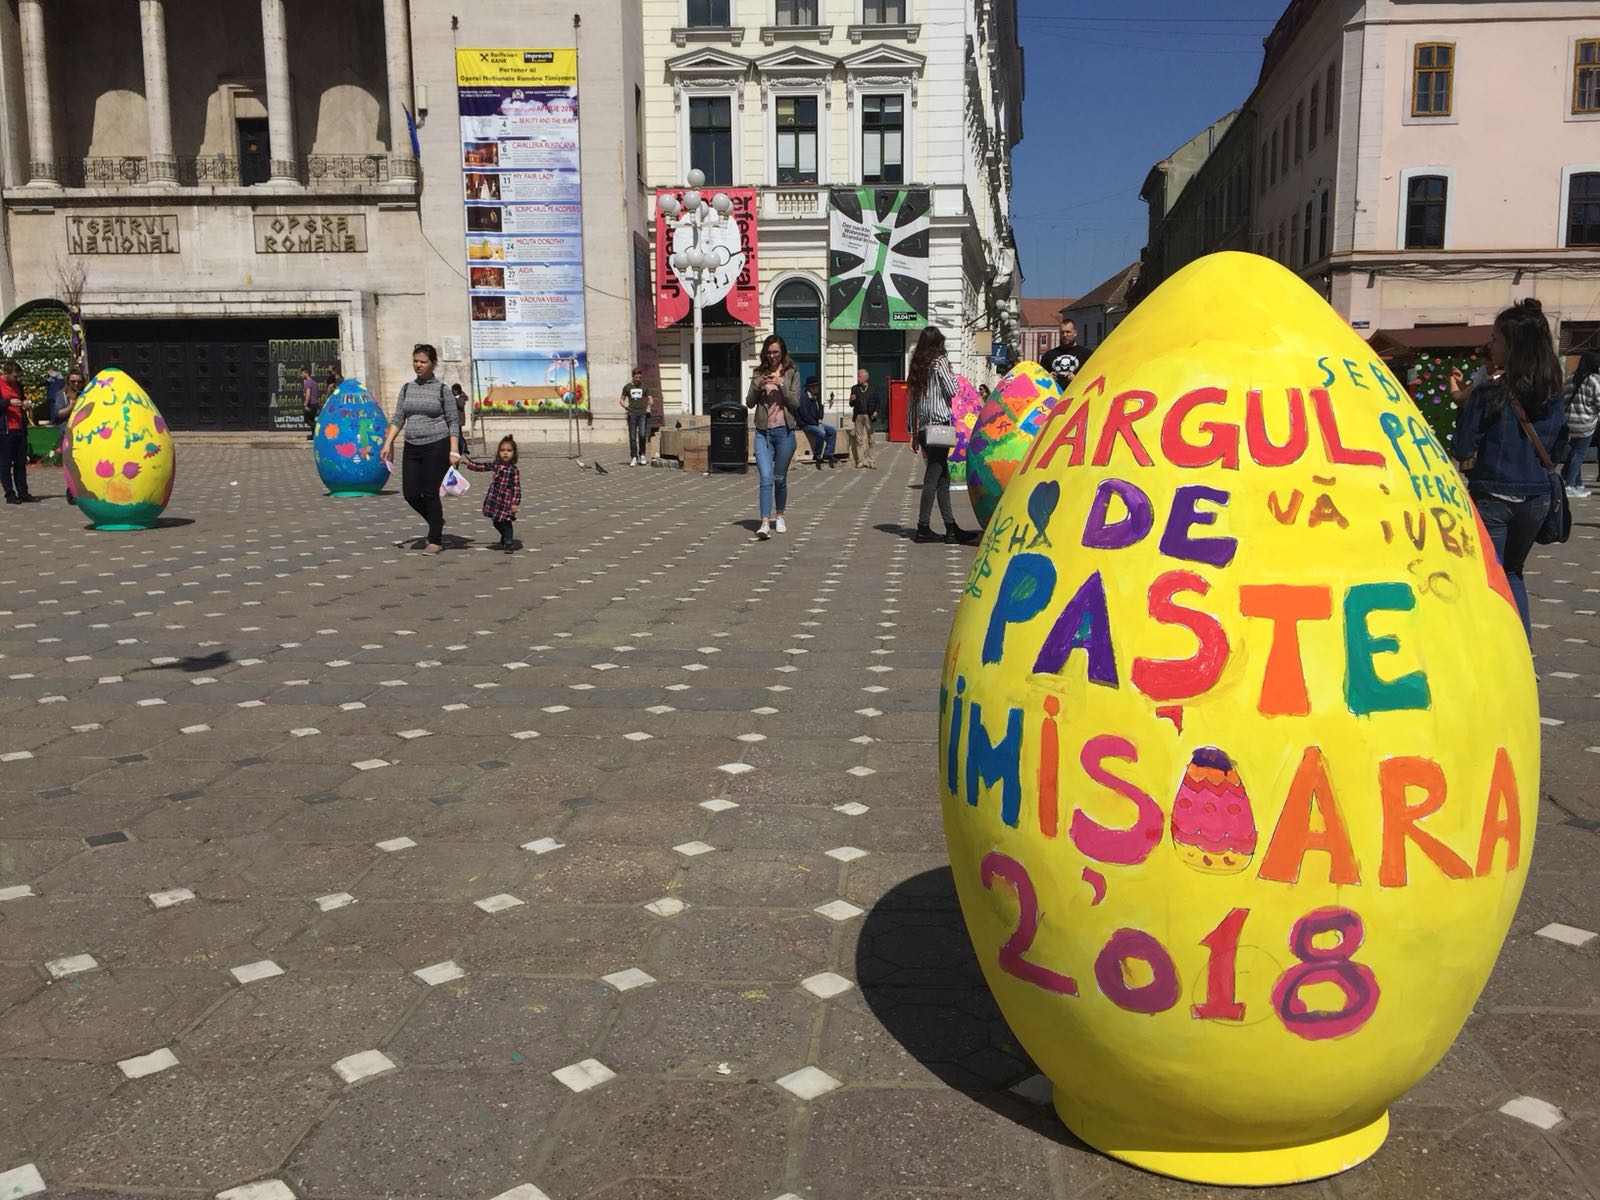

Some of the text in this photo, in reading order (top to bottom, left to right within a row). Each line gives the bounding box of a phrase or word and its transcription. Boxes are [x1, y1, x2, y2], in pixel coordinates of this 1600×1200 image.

[1019, 376, 1386, 476] TÂRGUL
[1081, 478, 1238, 568] DE
[980, 851, 1381, 1041] 2018
